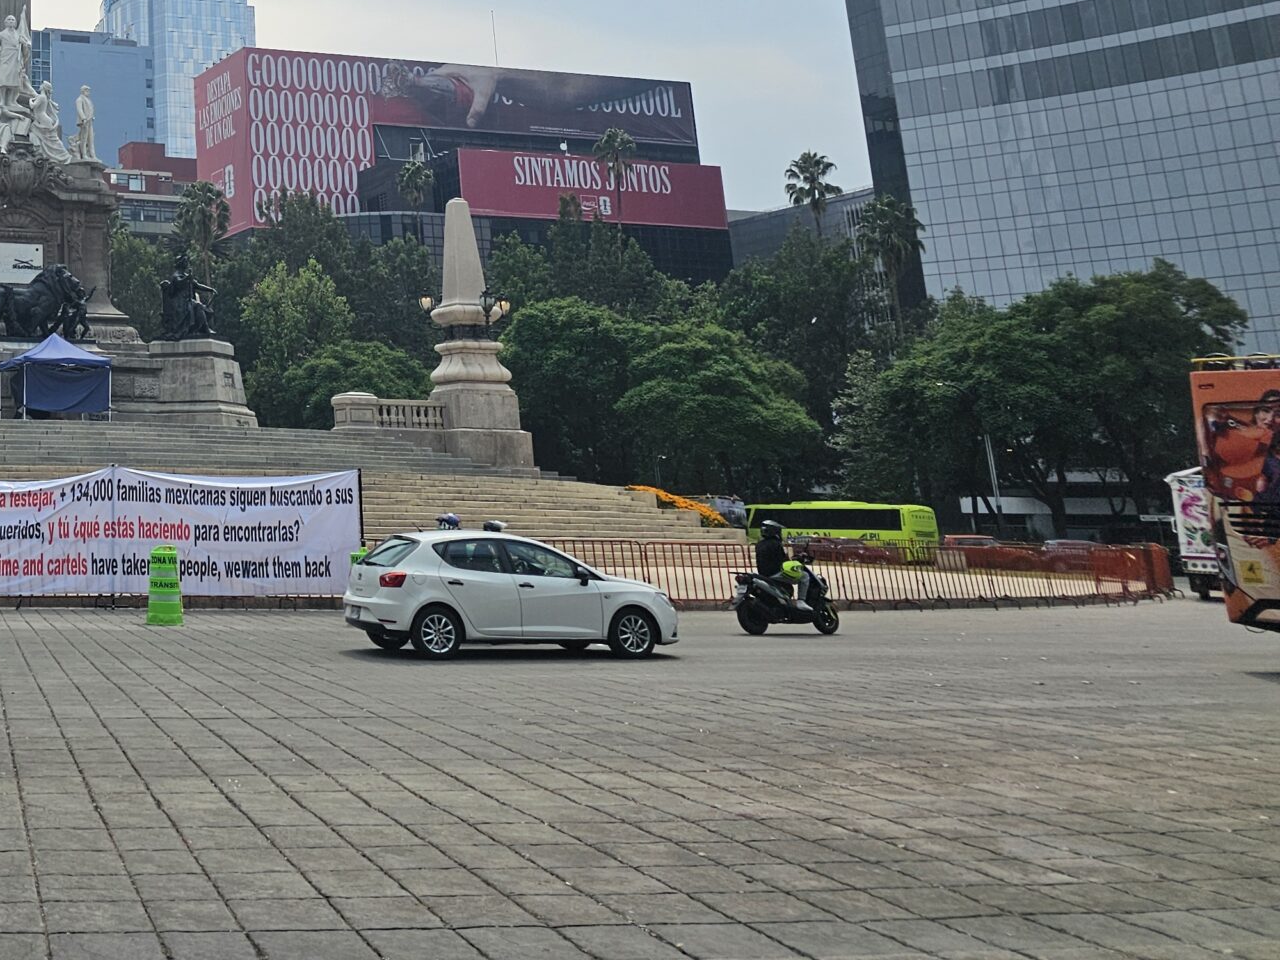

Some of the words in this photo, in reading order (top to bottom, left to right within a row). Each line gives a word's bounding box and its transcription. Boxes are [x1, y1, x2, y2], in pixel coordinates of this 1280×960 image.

[207, 71, 231, 103] DESTAPA
[199, 105, 210, 130] LAS
[209, 86, 242, 125] EMOCIONES
[206, 127, 214, 149] DE
[214, 121, 223, 145] UN
[252, 154, 371, 194] OOOOOOO
[513, 155, 602, 190] SINTAMOS
[606, 162, 672, 194] JUNTOS
[10, 488, 57, 512] festejar,
[59, 487, 67, 500] +
[71, 478, 114, 506] 134,000
[117, 478, 162, 504] familias
[165, 484, 227, 507] mexicanas
[229, 486, 267, 512] siguen
[270, 484, 323, 507] buscando
[325, 489, 333, 505] a
[335, 487, 354, 505] sus
[48, 521, 55, 545] y
[58, 515, 70, 538] tú
[73, 515, 100, 544] ¿qué
[103, 515, 135, 539] estás
[138, 517, 191, 540] haciendo
[194, 524, 220, 547] para
[223, 519, 301, 543] encontrarlas?
[22, 553, 44, 576] and
[47, 552, 88, 576] cartels
[91, 552, 118, 576] have
[180, 555, 221, 582] people,
[273, 555, 302, 579] them
[305, 554, 332, 578] back
[151, 555, 167, 565] ZONA
